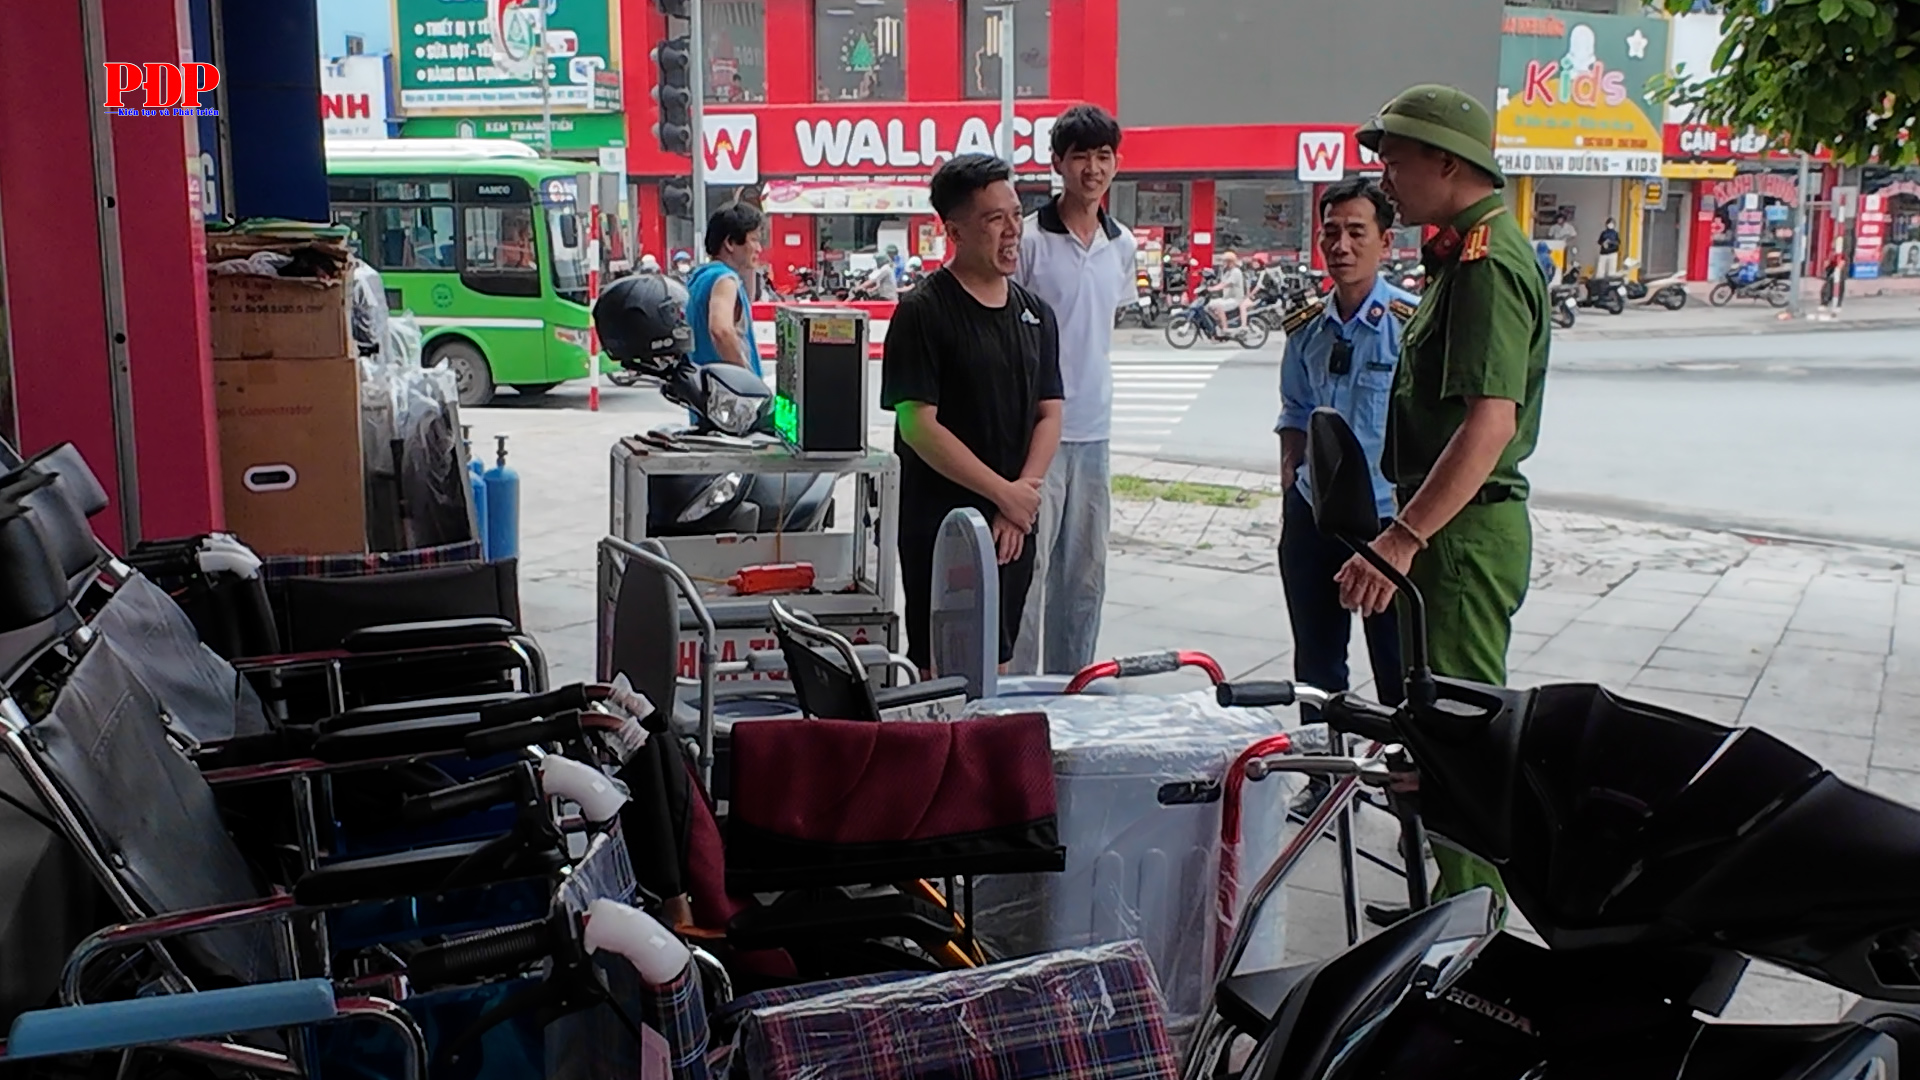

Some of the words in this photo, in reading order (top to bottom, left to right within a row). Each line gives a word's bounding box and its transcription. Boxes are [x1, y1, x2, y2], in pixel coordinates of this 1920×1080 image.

[1523, 59, 1627, 107] Kids
[485, 121, 508, 132] KEM
[703, 127, 752, 171] W
[1303, 142, 1341, 171] W
[1534, 156, 1564, 172] DINH
[1625, 158, 1658, 173] KIDS
[1446, 986, 1533, 1034] HONDA
